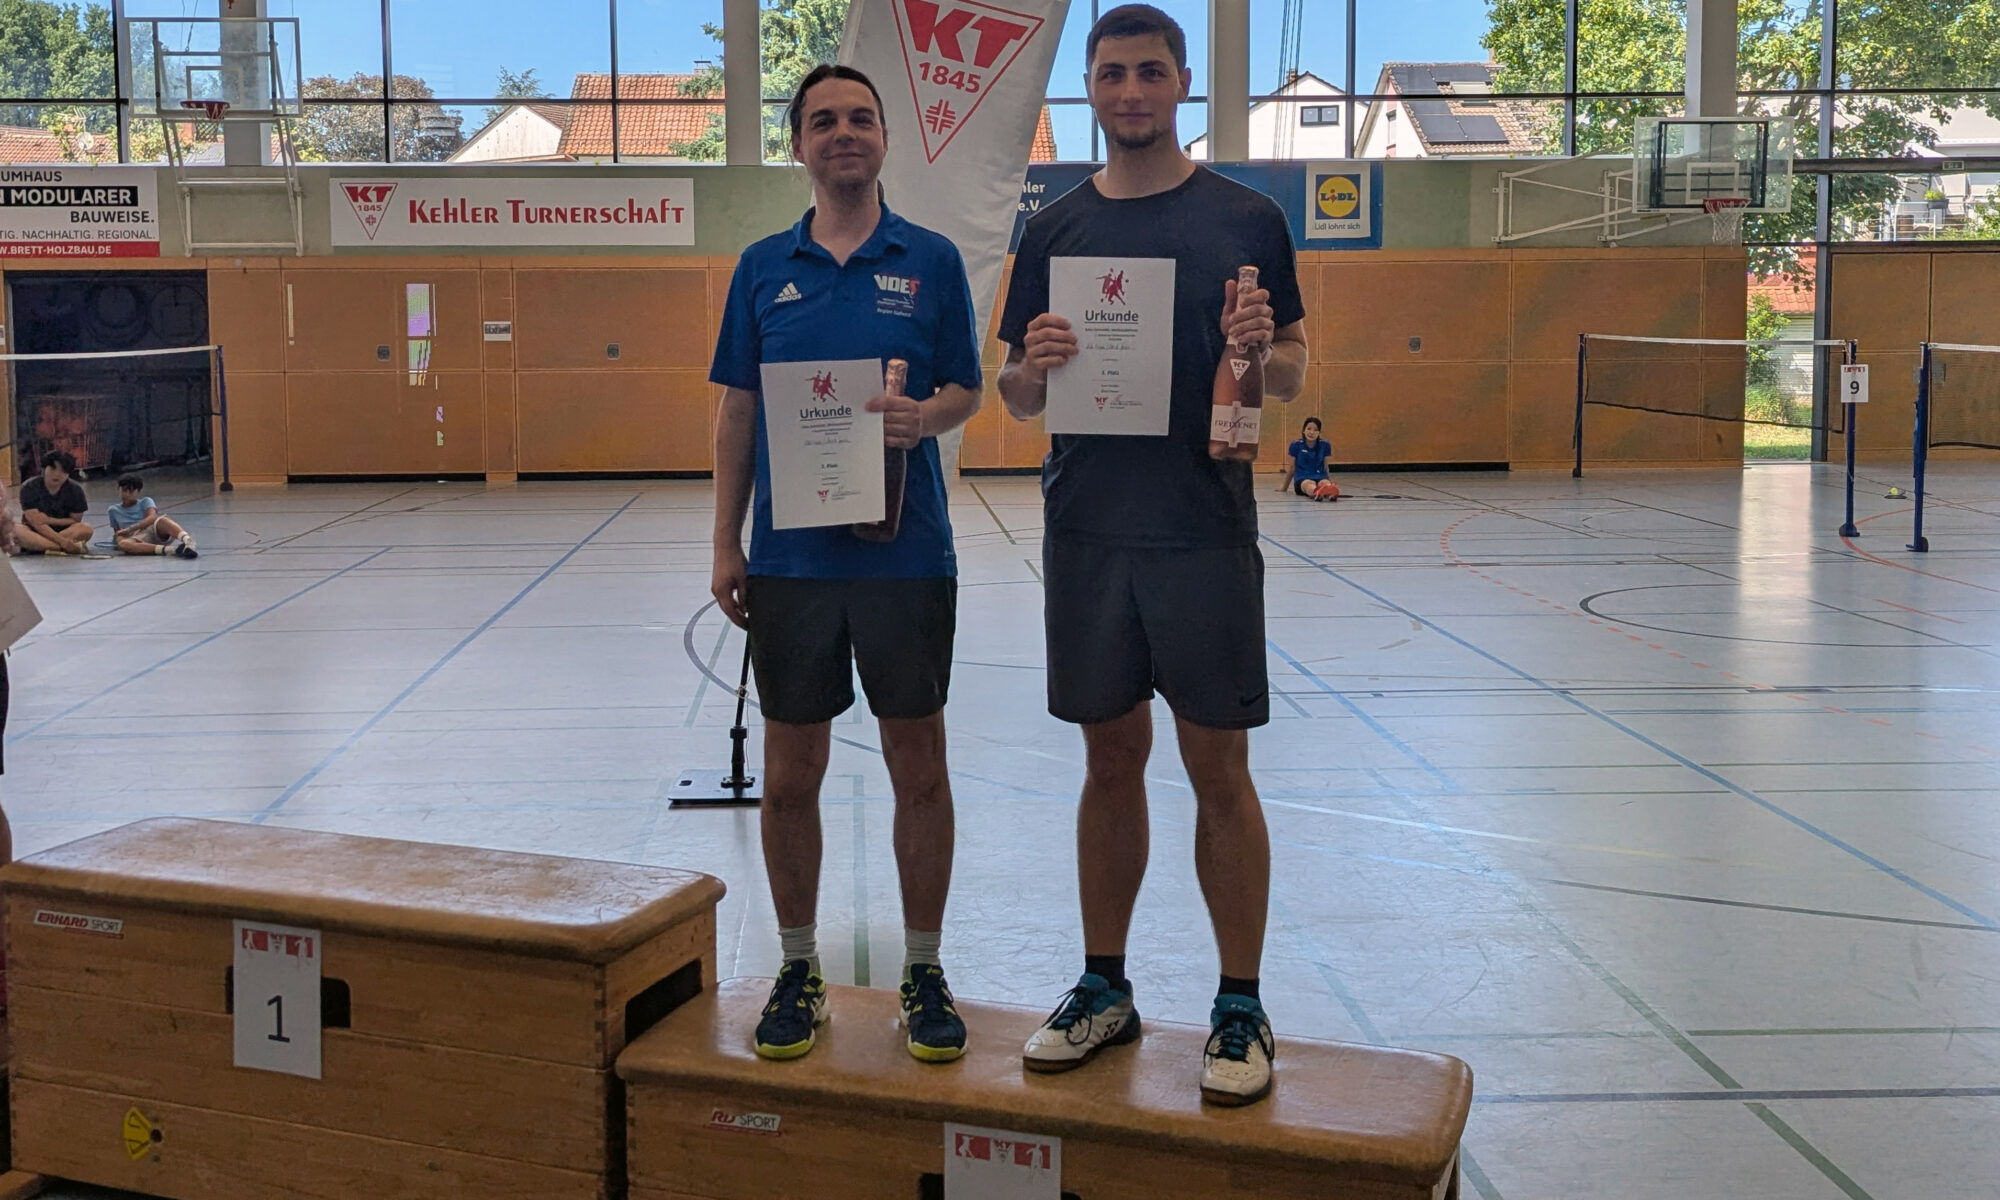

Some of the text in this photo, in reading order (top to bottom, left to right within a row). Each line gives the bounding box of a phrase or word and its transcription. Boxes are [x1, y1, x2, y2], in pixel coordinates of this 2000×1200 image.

[904, 0, 1029, 69] KT
[919, 62, 982, 93] 1845
[11, 188, 132, 204] MODULARER
[345, 186, 393, 203] KT
[357, 204, 382, 212] 1845
[70, 210, 155, 223] BAUWEISE.
[22, 230, 94, 240] NACHHALTIG.
[98, 230, 156, 240] REGIONAL.
[1085, 309, 1139, 322] Urkunde
[1850, 380, 1860, 395] 9
[800, 405, 853, 419] Urkunde
[38, 912, 89, 928] ERHARD
[266, 995, 291, 1043] 1
[739, 1114, 777, 1129] SPORT
